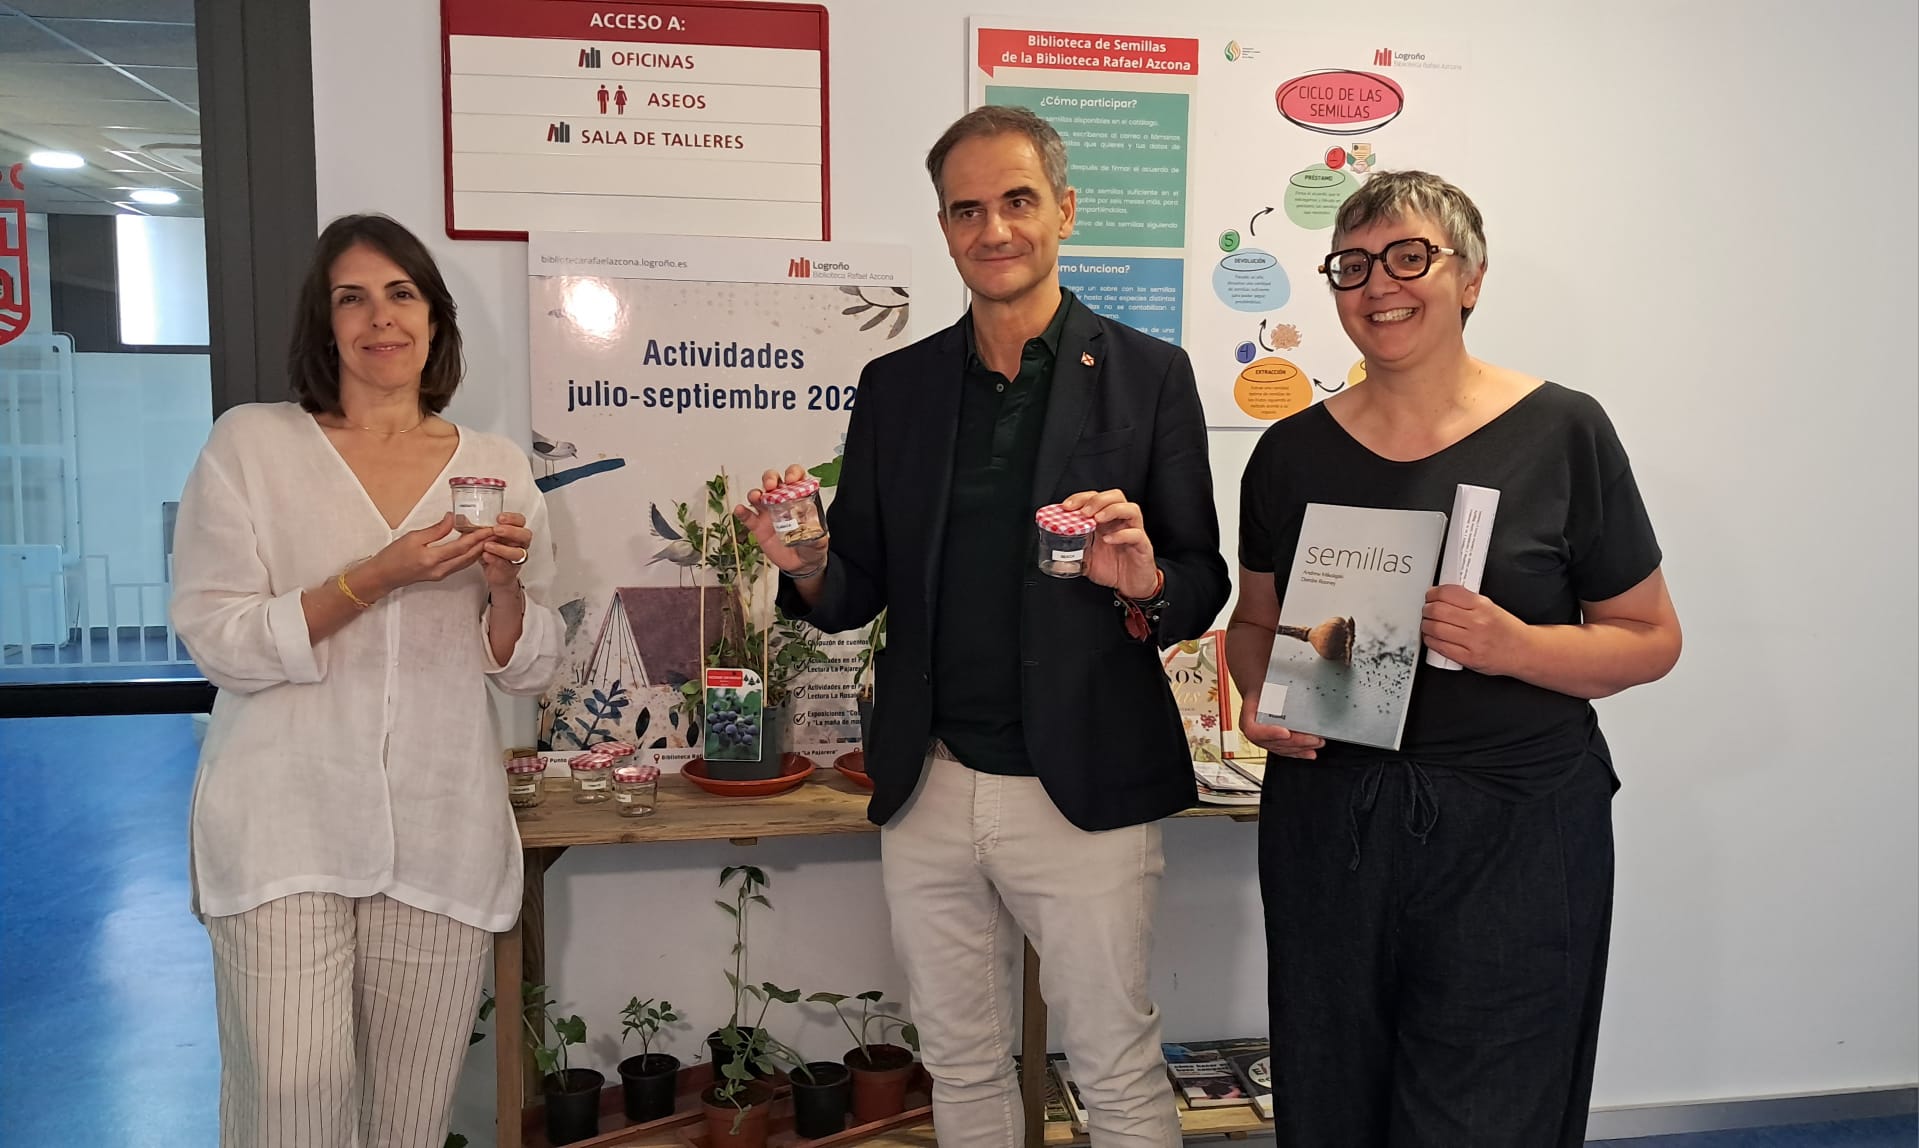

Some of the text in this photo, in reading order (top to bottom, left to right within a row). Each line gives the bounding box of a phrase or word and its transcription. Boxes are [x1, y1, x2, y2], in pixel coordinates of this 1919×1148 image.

[590, 13, 686, 31] ACCESO A:
[1028, 35, 1167, 53] Biblioteca de Semillas
[611, 51, 695, 70] OFICINAS
[1001, 52, 1191, 71] de la Biblioteca Rafael Azcona
[1394, 51, 1426, 62] Logroño
[647, 93, 706, 110] ASEOS
[1299, 85, 1382, 102] CICLO DE LAS
[1040, 96, 1137, 110] ¿Cómo participar?
[1310, 104, 1370, 118] SEMILLAS
[581, 129, 744, 150] SALA DE TALLERES
[1224, 234, 1234, 247] 5
[813, 261, 850, 271] Logroño
[1080, 263, 1131, 274] funciona?
[813, 271, 846, 279] Biblioteca
[847, 272, 868, 280] Rafael
[642, 339, 805, 370] Actividades
[1240, 344, 1249, 360] 4
[568, 380, 857, 414] julio-septiembre 202
[1305, 546, 1413, 574] semillas
[807, 683, 841, 691] Actividades
[807, 692, 829, 700] Lectura
